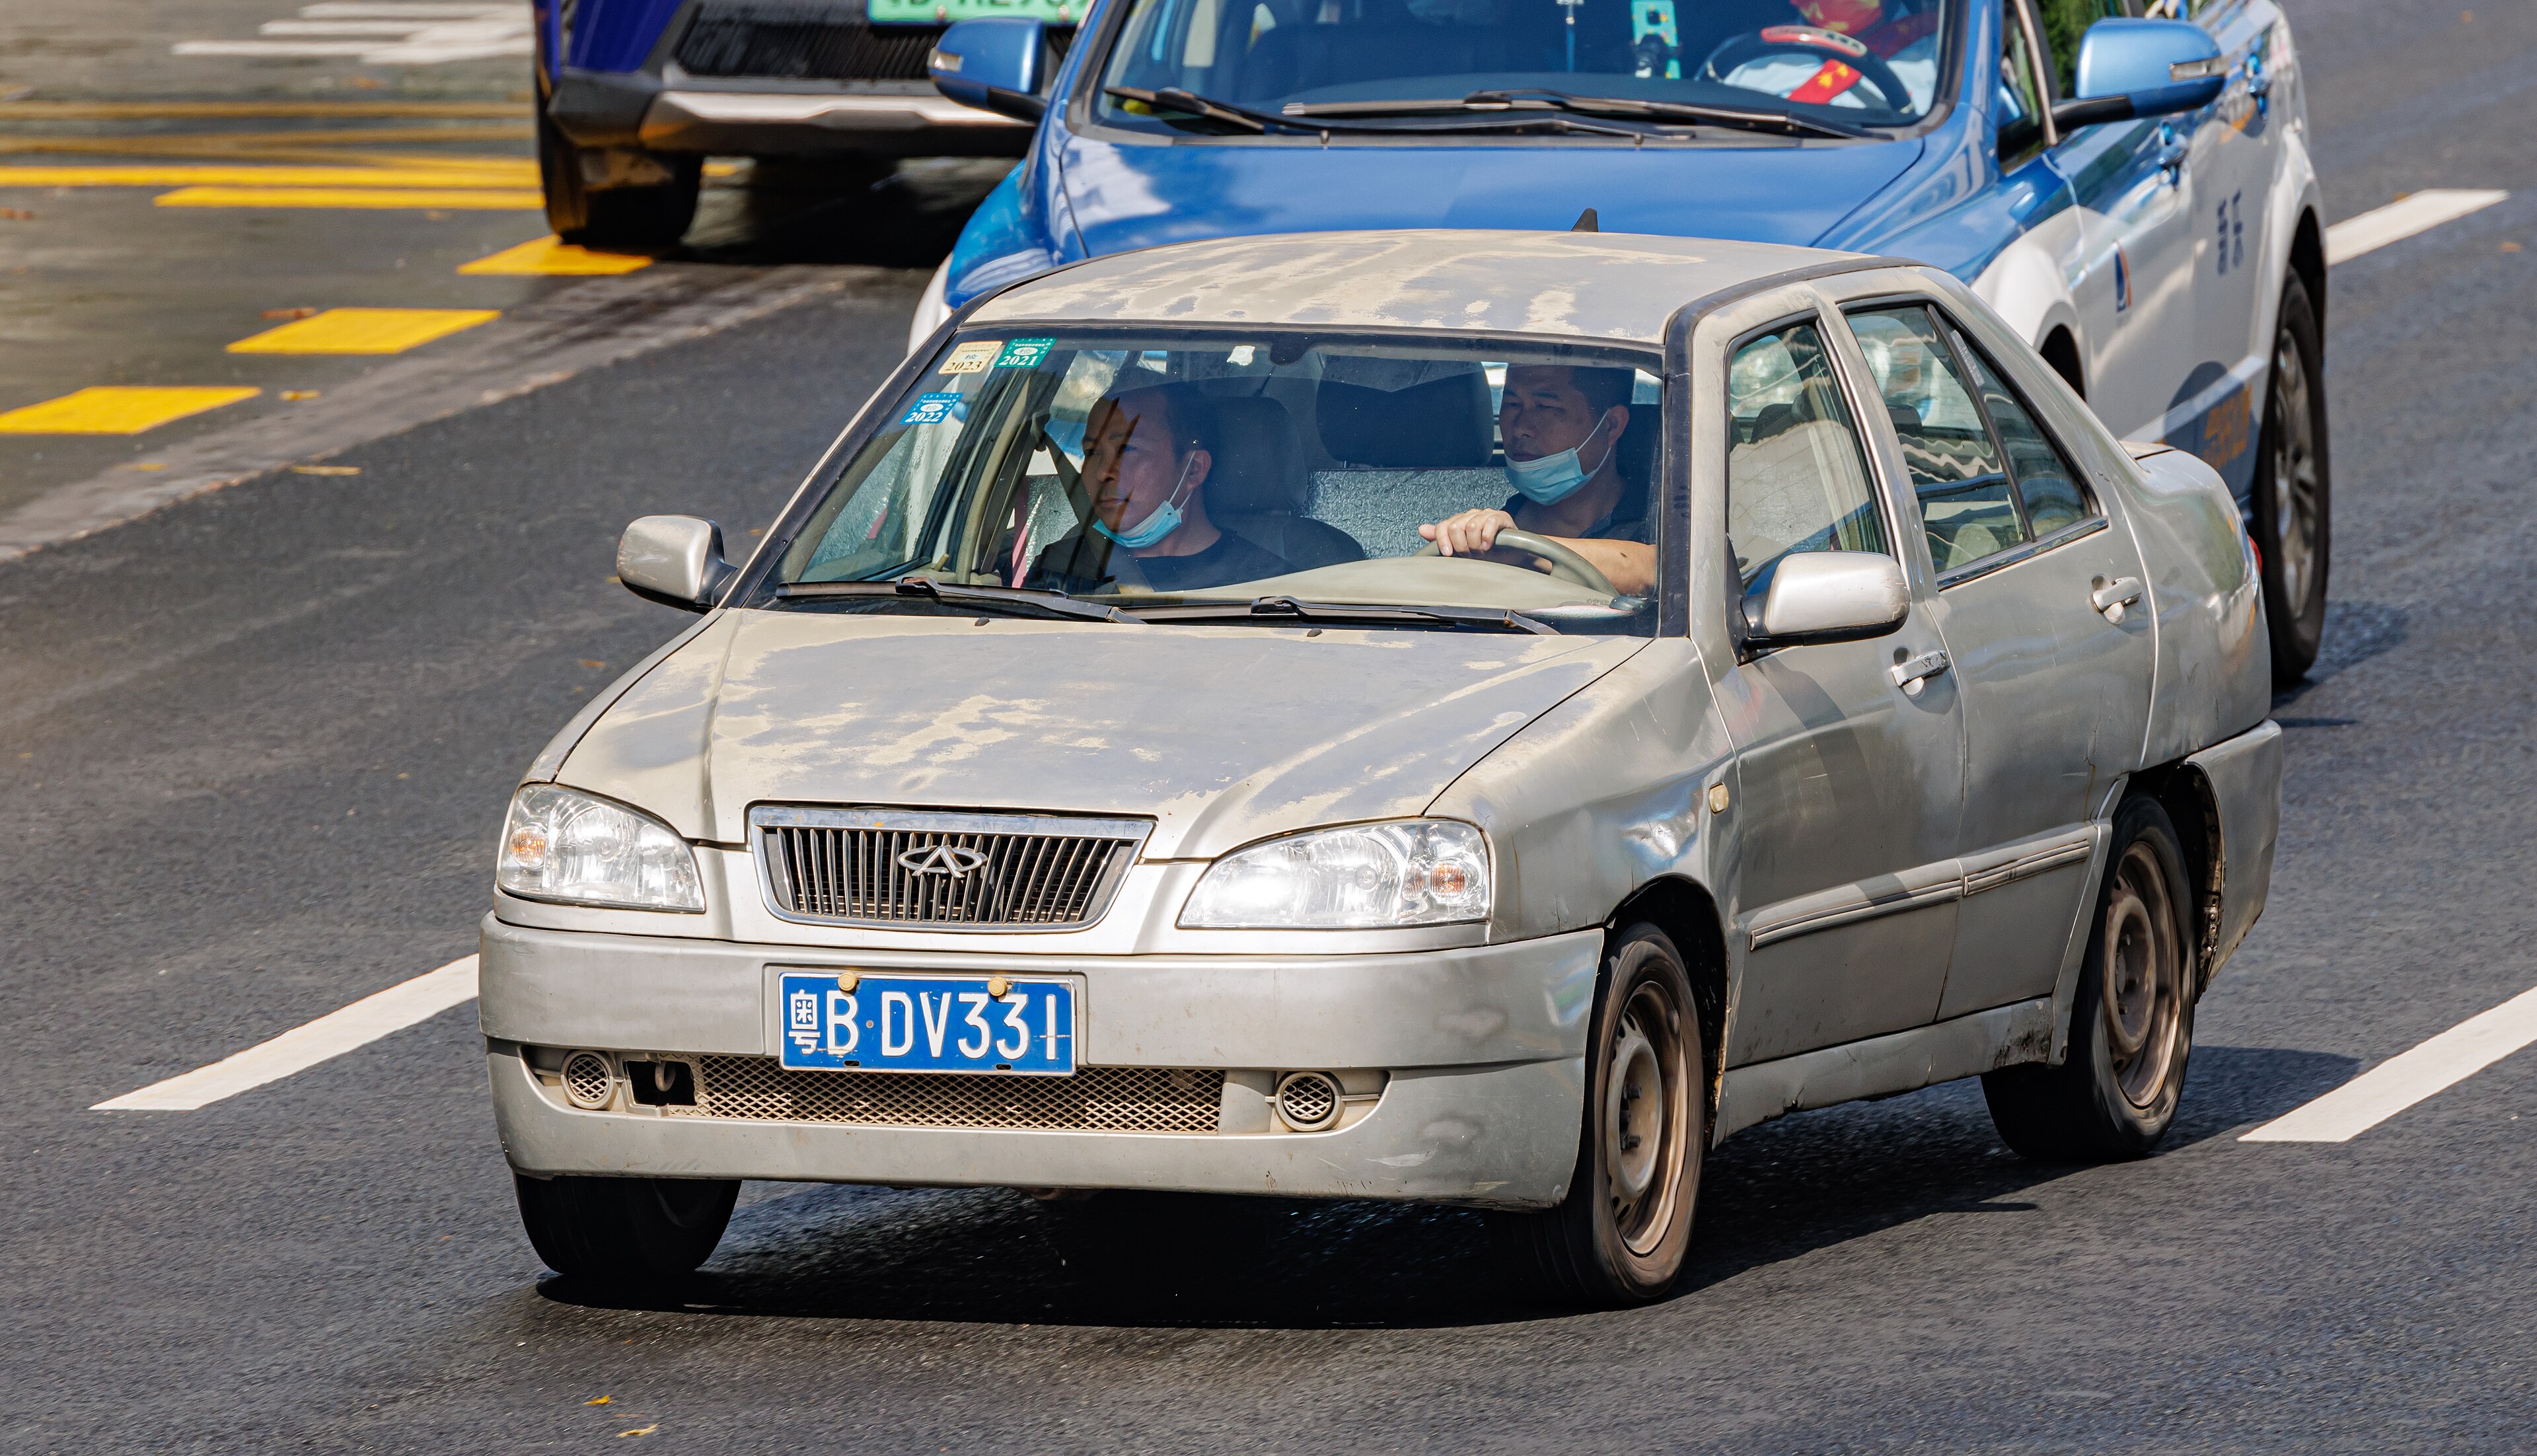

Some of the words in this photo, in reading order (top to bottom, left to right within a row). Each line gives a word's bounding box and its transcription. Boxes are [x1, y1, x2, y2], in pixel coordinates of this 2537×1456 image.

[944, 360, 982, 371] 2023
[998, 355, 1038, 366] 2021
[904, 411, 943, 423] 2022
